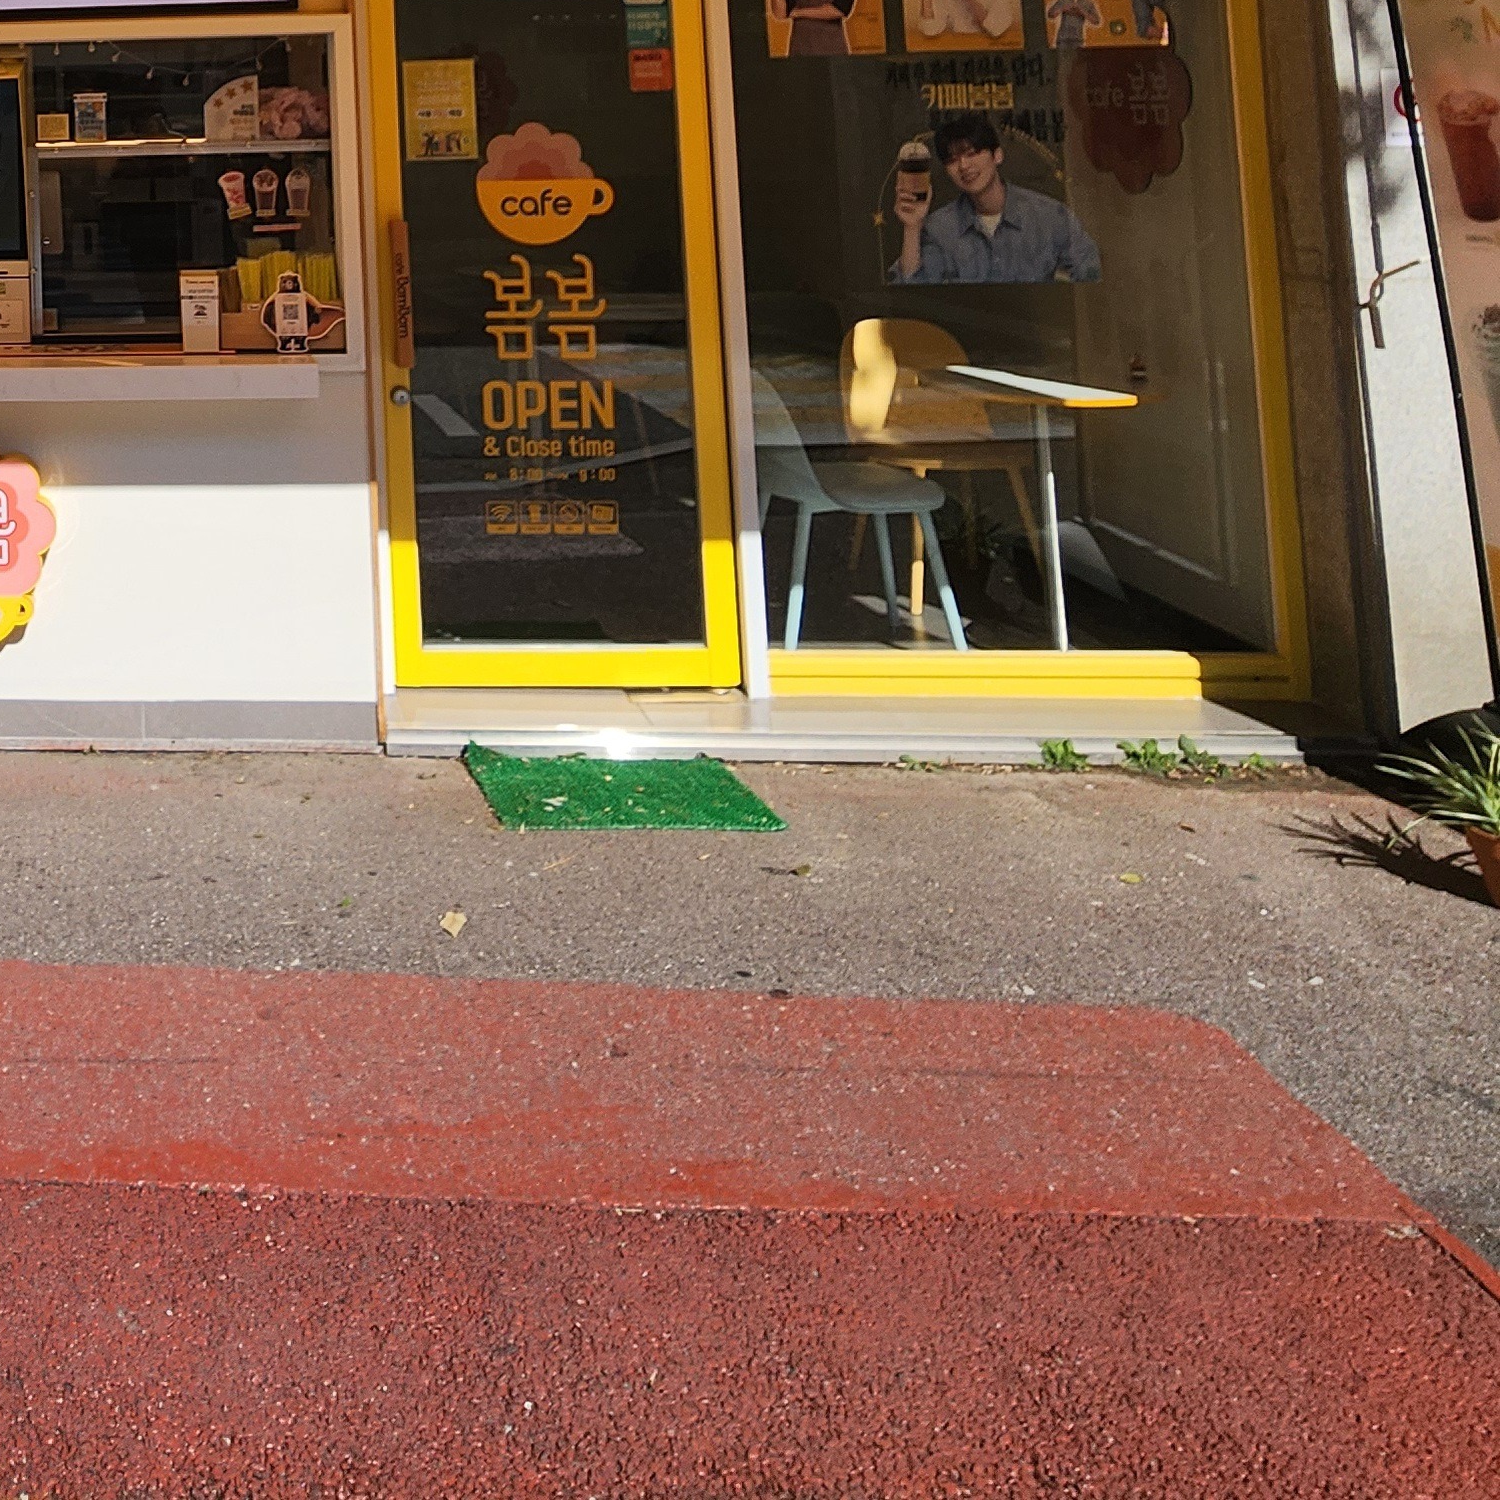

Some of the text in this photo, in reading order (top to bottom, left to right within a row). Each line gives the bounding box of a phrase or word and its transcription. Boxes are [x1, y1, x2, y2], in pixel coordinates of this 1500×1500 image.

[500, 188, 574, 218] cafe
[483, 254, 607, 361] 봄봄
[482, 379, 616, 431] OPEN
[483, 436, 616, 458] & Close time
